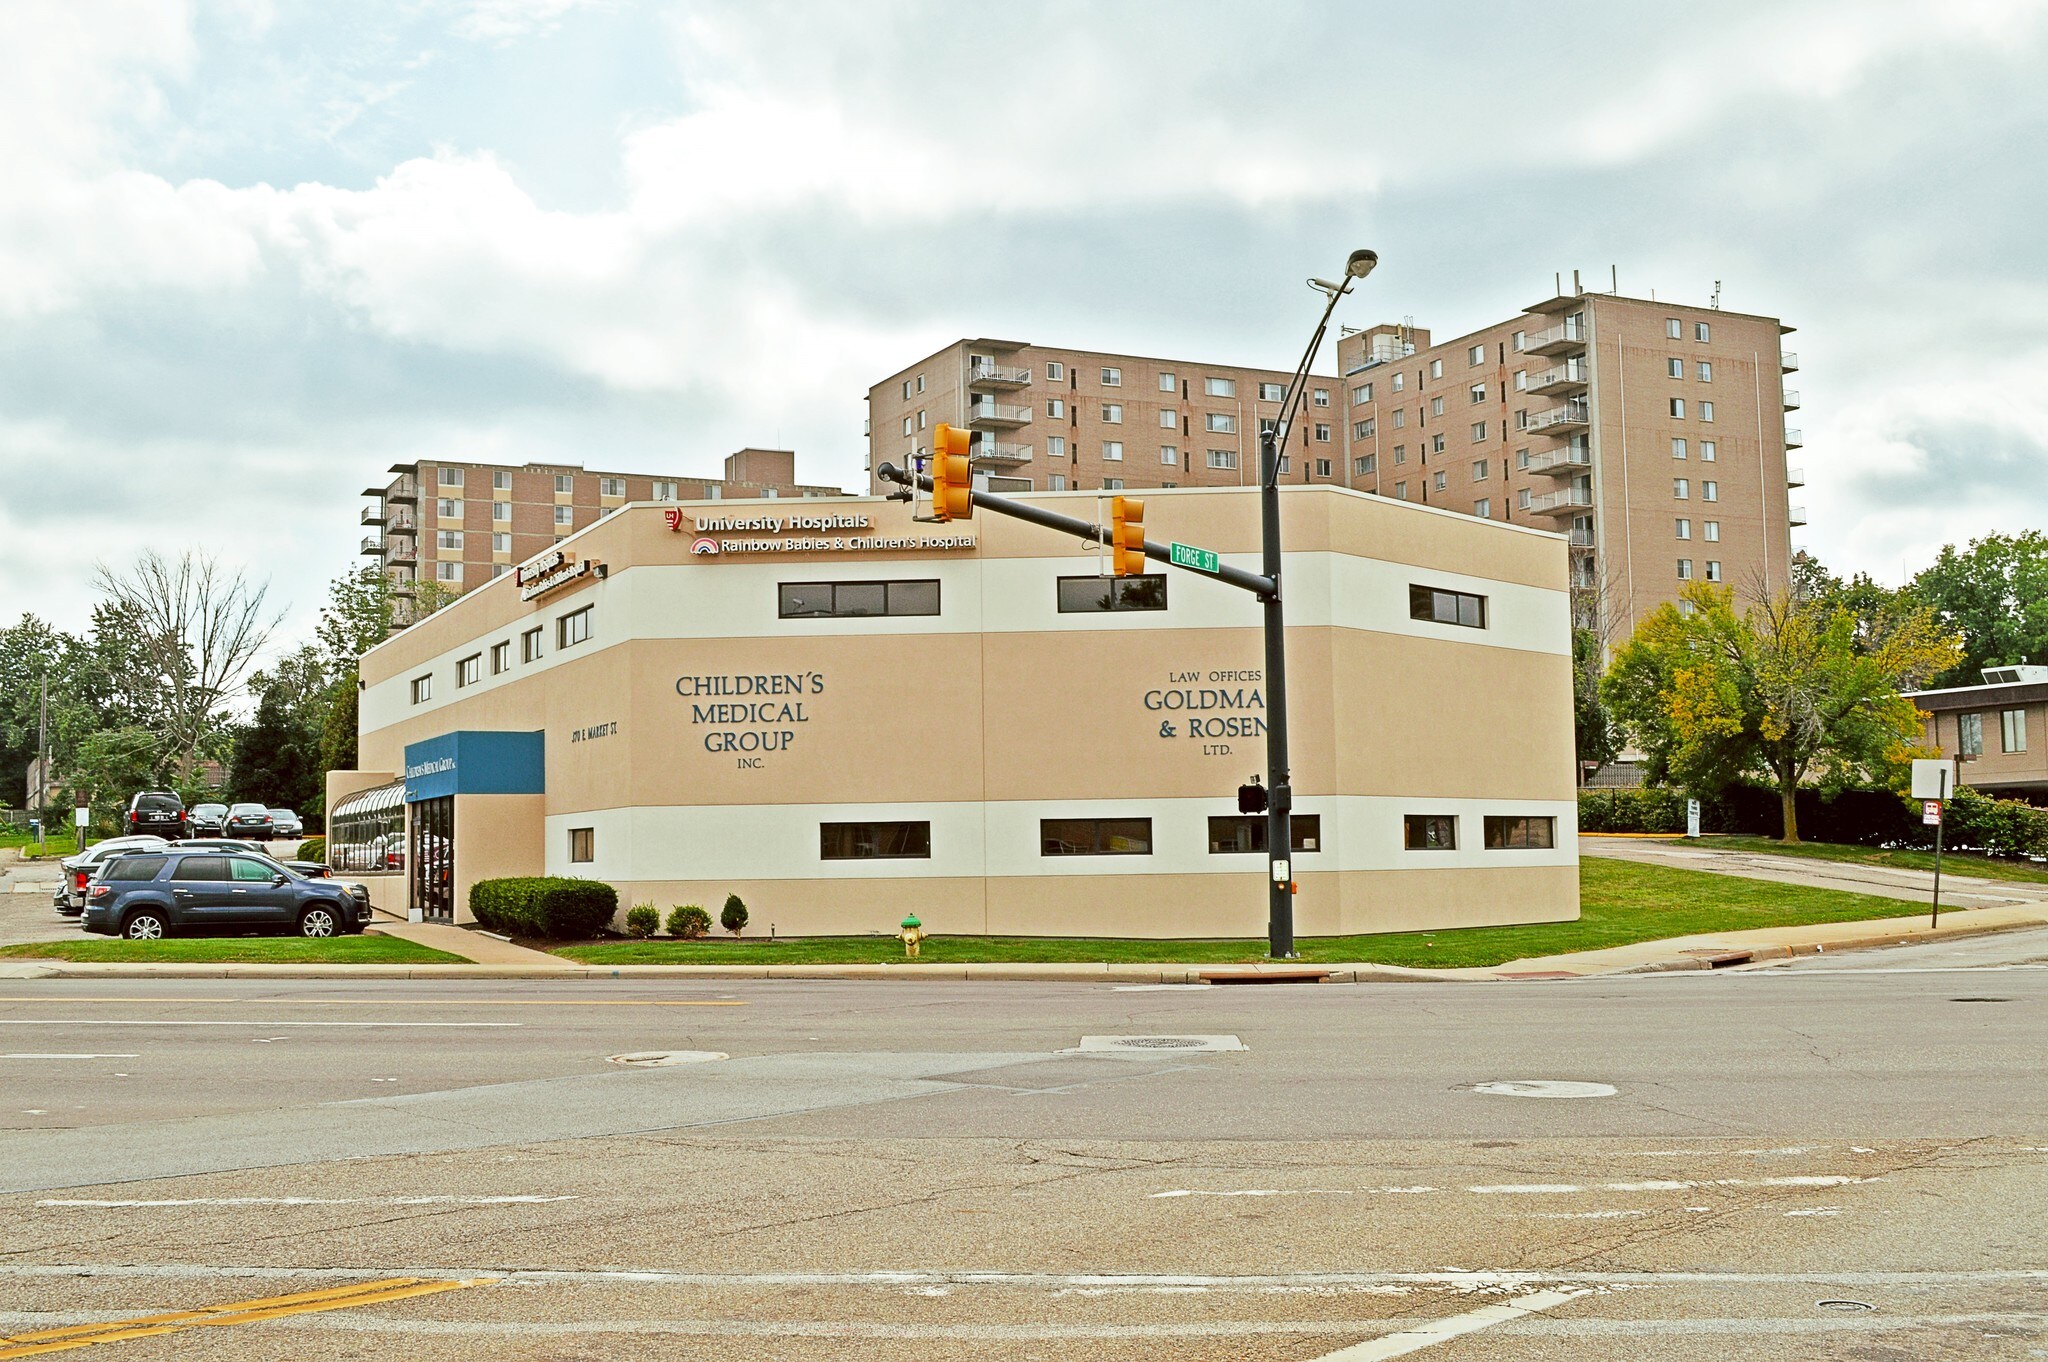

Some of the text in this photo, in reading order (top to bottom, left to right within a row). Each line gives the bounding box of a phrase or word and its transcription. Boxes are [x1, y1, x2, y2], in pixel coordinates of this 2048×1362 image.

[695, 513, 868, 533] University Hospitals
[721, 535, 976, 552] Rainbow Babies & Children's Hospital
[1176, 546, 1213, 569] FORGE ST
[676, 671, 824, 697] CHILDREN'S
[1170, 670, 1262, 683] LAW OFFICES
[1144, 688, 1265, 710] GOLDMA
[692, 702, 809, 724] MEDICAL
[588, 723, 609, 740] MARKET
[1159, 719, 1177, 738] &
[704, 731, 794, 752] GROUP
[1203, 744, 1233, 755] LTD.
[737, 757, 765, 769] INC.
